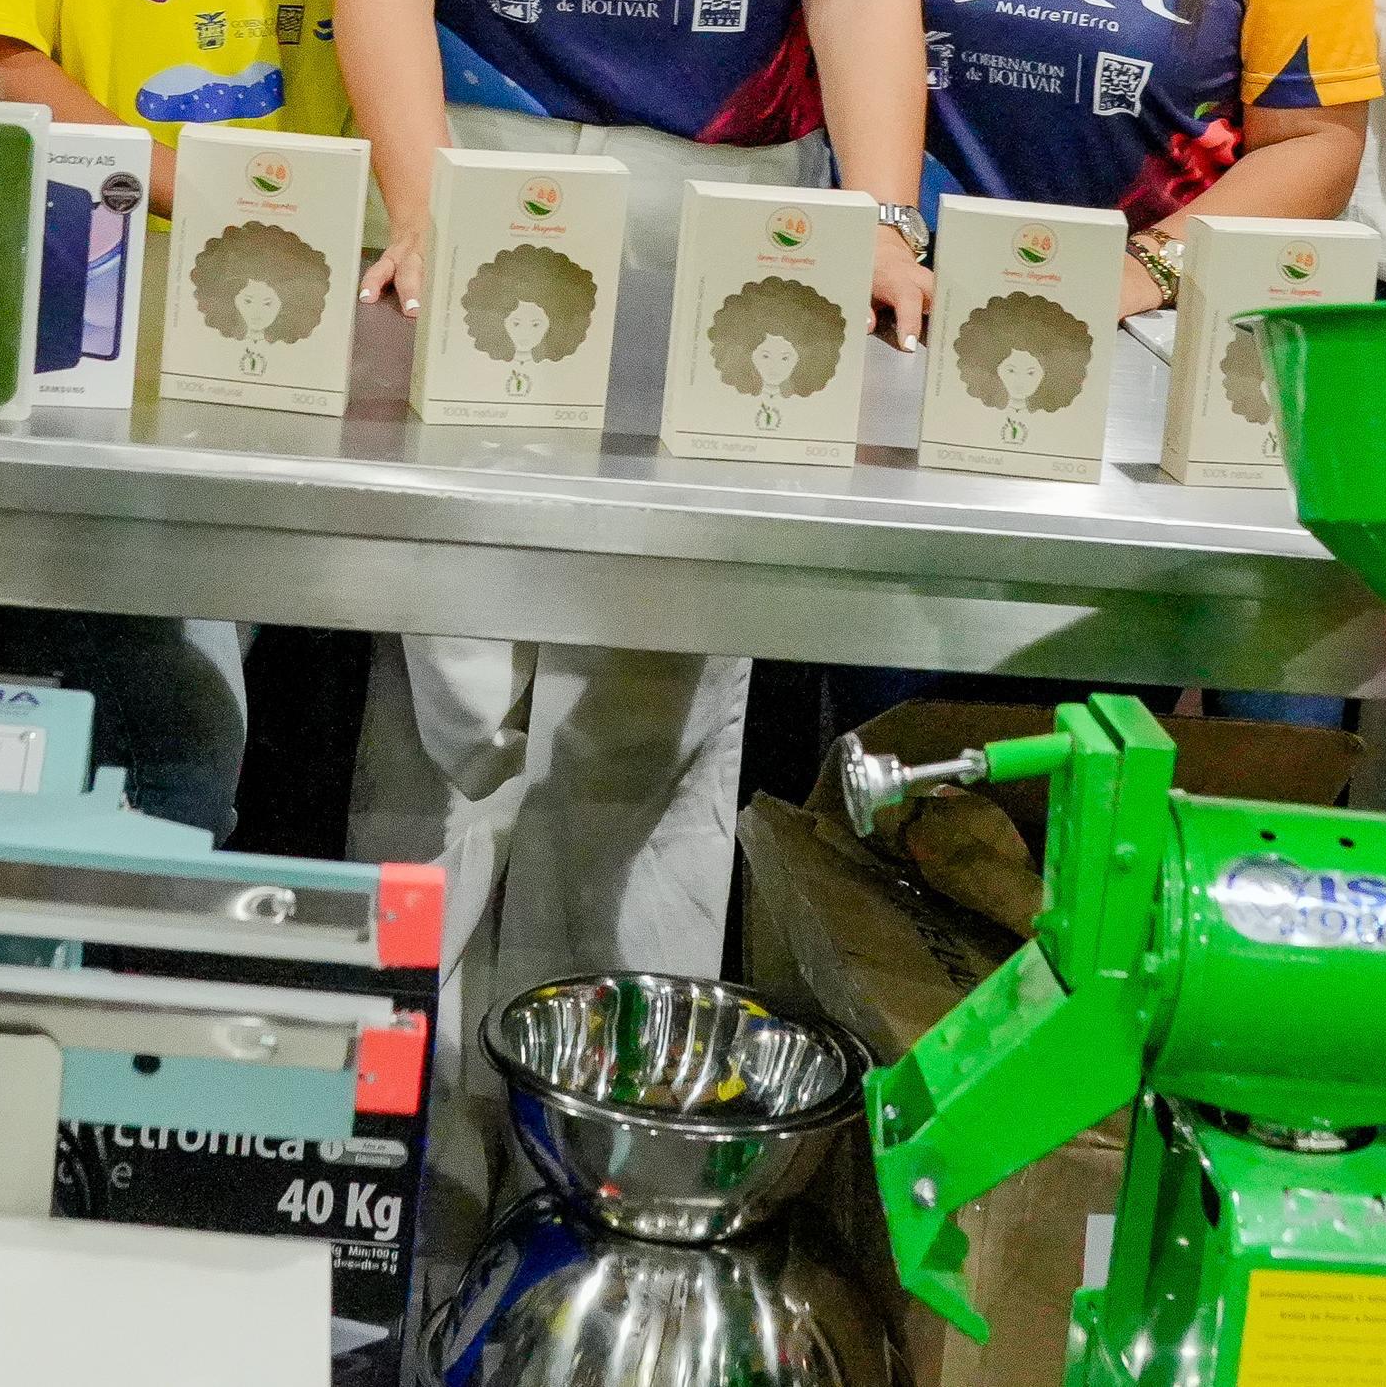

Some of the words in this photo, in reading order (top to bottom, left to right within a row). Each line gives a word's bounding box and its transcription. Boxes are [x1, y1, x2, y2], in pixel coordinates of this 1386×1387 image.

[557, 0, 575, 12] de
[276, 1178, 334, 1225] 40
[345, 1182, 402, 1242] Kg
